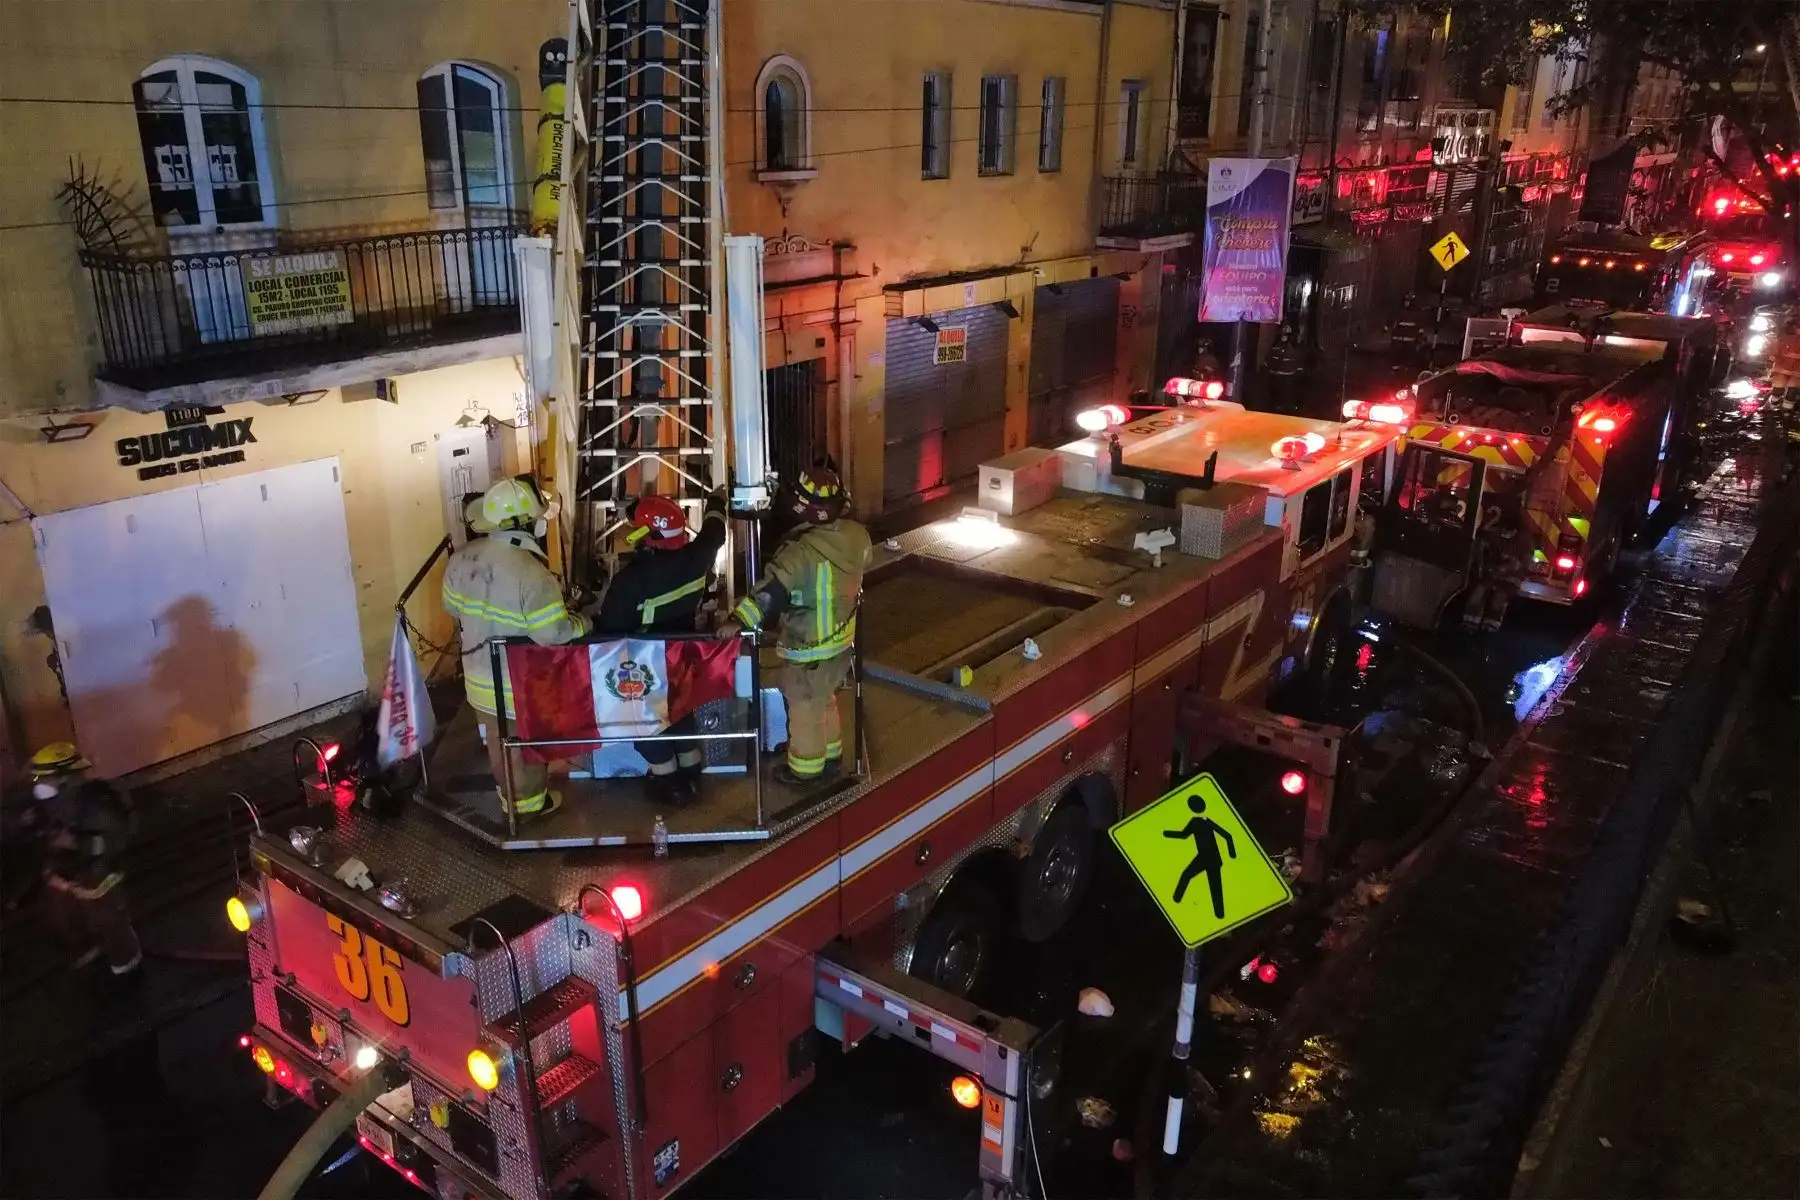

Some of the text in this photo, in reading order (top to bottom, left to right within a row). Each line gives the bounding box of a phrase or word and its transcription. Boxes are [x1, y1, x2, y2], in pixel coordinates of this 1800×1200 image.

[251, 252, 339, 278] SE ALQUILA
[248, 271, 347, 293] LOCAL COMERCIAL
[258, 290, 283, 304] 15M2
[289, 287, 318, 300] LOCAL
[318, 283, 340, 297] 1195
[115, 416, 258, 467] SUCOMIX
[652, 515, 669, 529] 36
[326, 911, 412, 1028] 36
